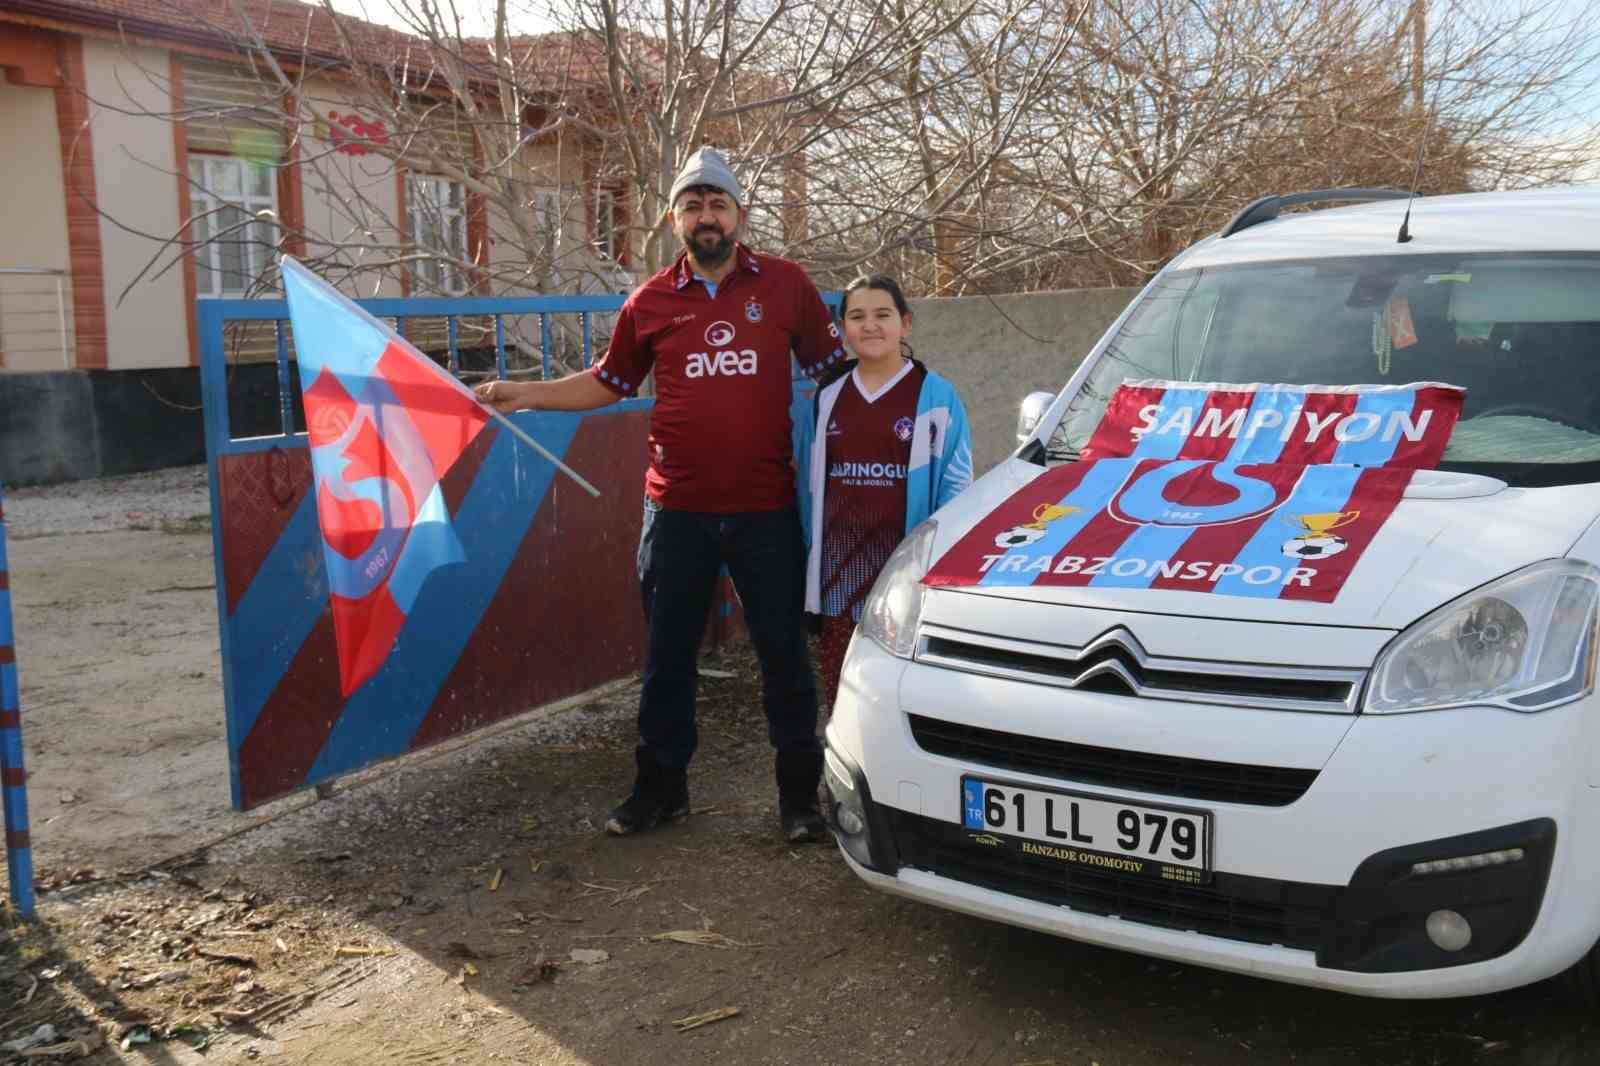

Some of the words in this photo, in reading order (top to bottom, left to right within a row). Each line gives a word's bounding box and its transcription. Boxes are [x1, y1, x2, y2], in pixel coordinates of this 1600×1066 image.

[685, 349, 758, 379] avea
[1131, 404, 1434, 443] ŞAMPİYON
[364, 547, 391, 579] 1967
[979, 554, 1318, 588] TRABZONSPOR
[968, 807, 984, 820] TR
[984, 788, 1025, 832] 61
[1045, 798, 1093, 844] LL
[1116, 809, 1196, 861] 979
[1022, 842, 1077, 861] HANZADE
